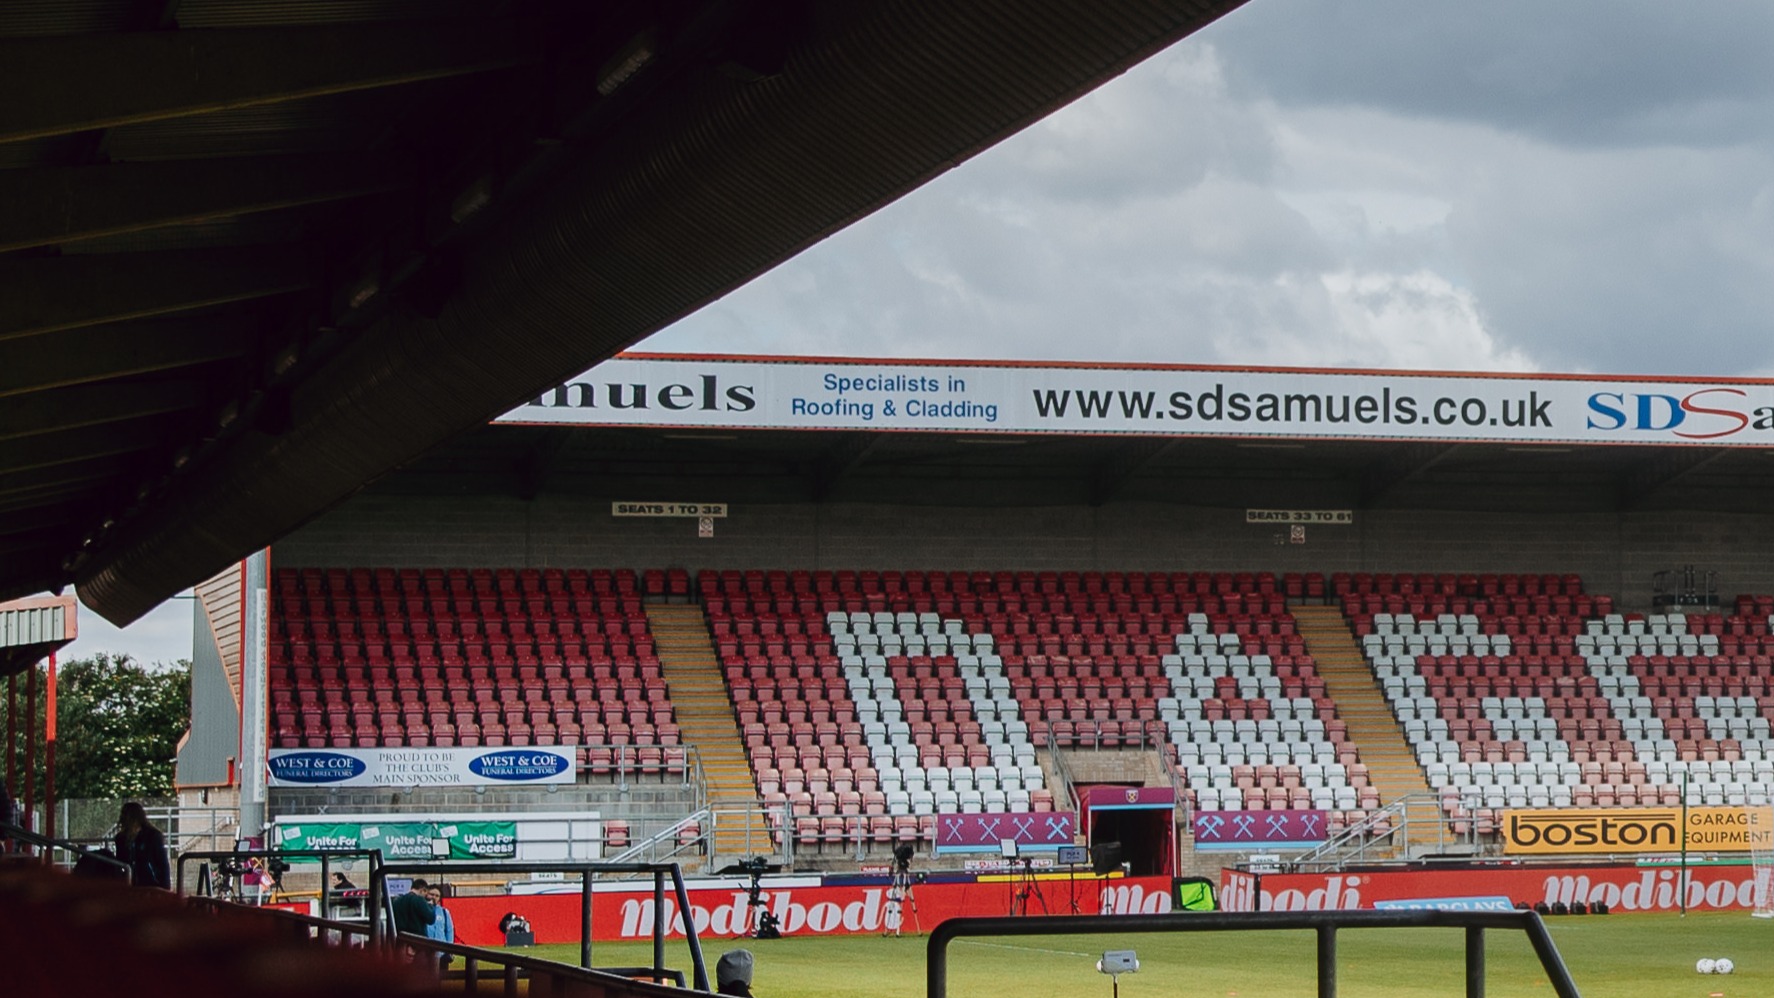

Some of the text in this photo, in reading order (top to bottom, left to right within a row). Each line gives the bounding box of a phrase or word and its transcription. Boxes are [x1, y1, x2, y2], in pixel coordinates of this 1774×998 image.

[823, 373, 966, 395] Specialists in
[791, 398, 998, 422] Roofing & Cladding
[1033, 384, 1553, 428] www.sdsamuels.co.uk
[618, 504, 722, 514] SEATS 1 TO 32
[1248, 511, 1290, 520] SEATS
[1294, 512, 1312, 520] 33
[1316, 512, 1333, 520] TO
[379, 752, 455, 762] PROUD TO BE
[481, 755, 557, 766] WEST & COE
[276, 758, 354, 768] WEST & COE
[386, 763, 450, 772] THE CLUB'S
[276, 769, 353, 778] FUNERAL DIRECTORS
[516, 767, 557, 775] DIRECTORS
[373, 774, 461, 783] MAIN SPONSOR
[1690, 812, 1758, 826] GARAGE
[1511, 815, 1676, 846] boston
[307, 835, 357, 846] Unite For
[385, 836, 415, 846] Unite
[464, 834, 514, 844] Unite For
[1684, 830, 1772, 845] EQUIPMENT
[390, 845, 431, 855] Acces
[469, 844, 514, 854] Access
[620, 890, 905, 937] Modibodi
